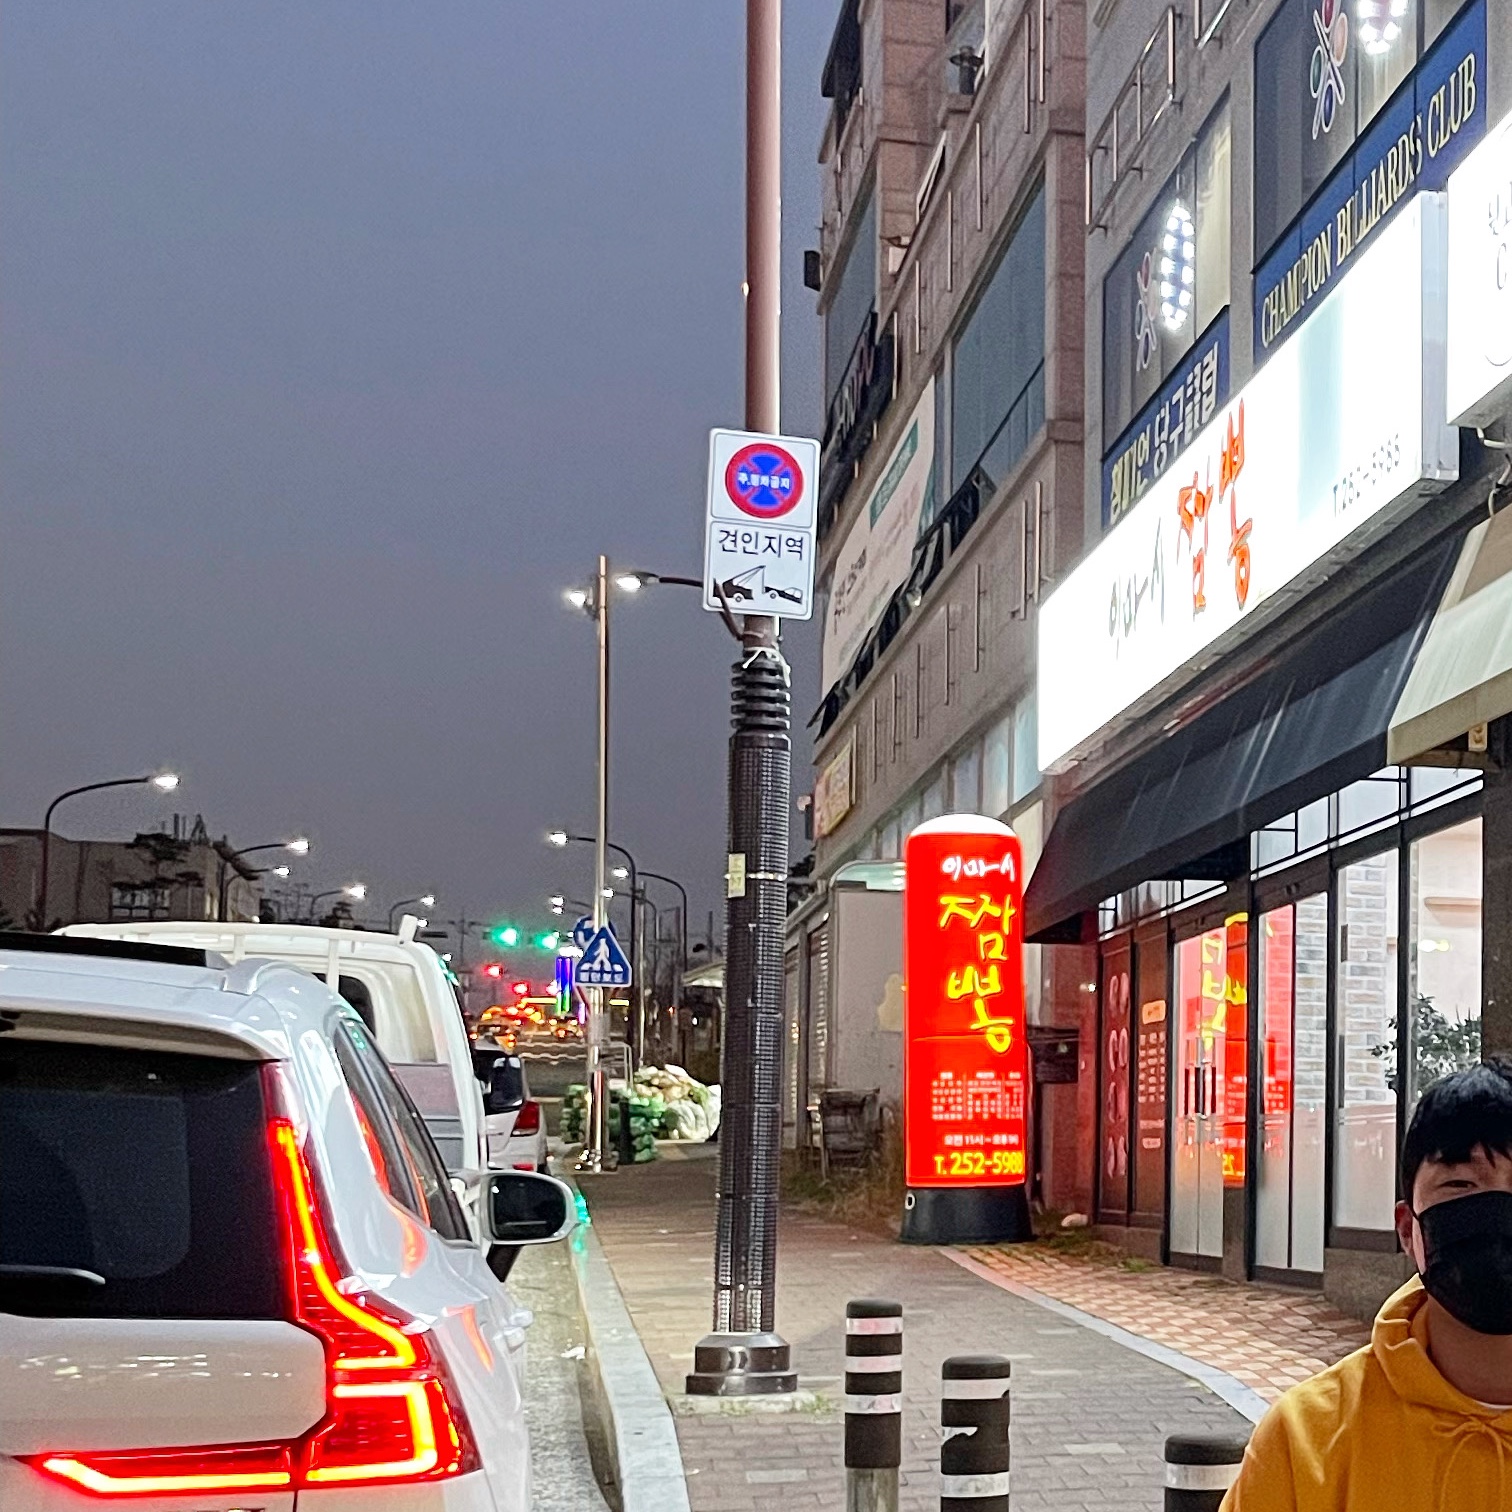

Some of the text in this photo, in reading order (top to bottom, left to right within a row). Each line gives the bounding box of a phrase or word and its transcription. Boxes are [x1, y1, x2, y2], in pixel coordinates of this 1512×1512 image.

[1262, 222, 1333, 348] CHAMPION
[1427, 52, 1476, 158] CLUB
[719, 529, 804, 560] 견인지역
